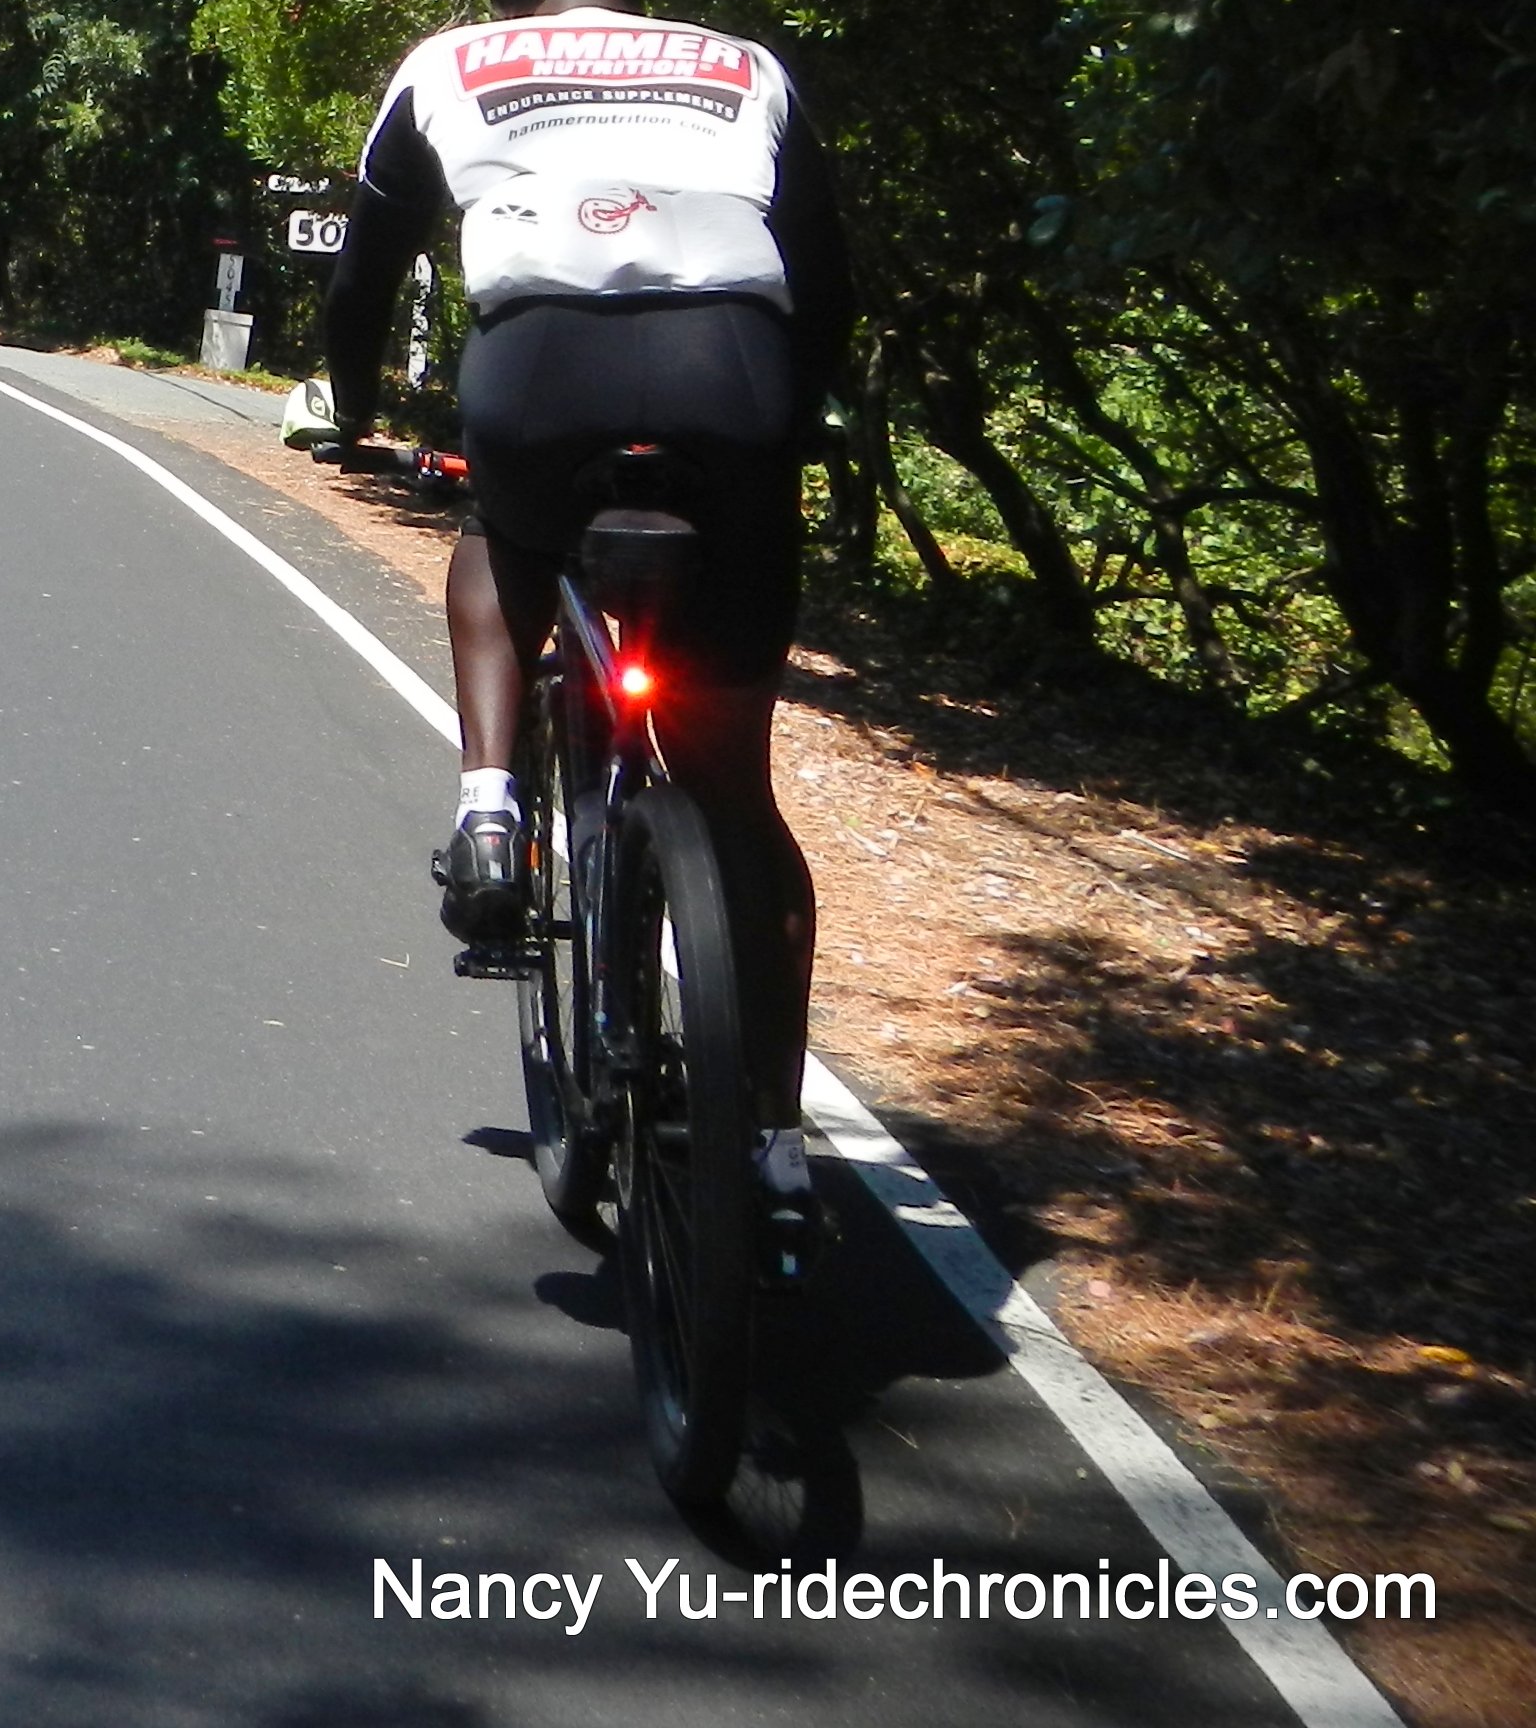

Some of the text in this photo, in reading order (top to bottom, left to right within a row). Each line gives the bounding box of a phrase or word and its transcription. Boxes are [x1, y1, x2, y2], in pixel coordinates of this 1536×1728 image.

[464, 31, 742, 73] HAMMER
[532, 59, 699, 76] NUTRITION
[486, 89, 735, 121] ENDURANCE SUPPLEMENTS
[508, 114, 717, 141] hammernutritioncom
